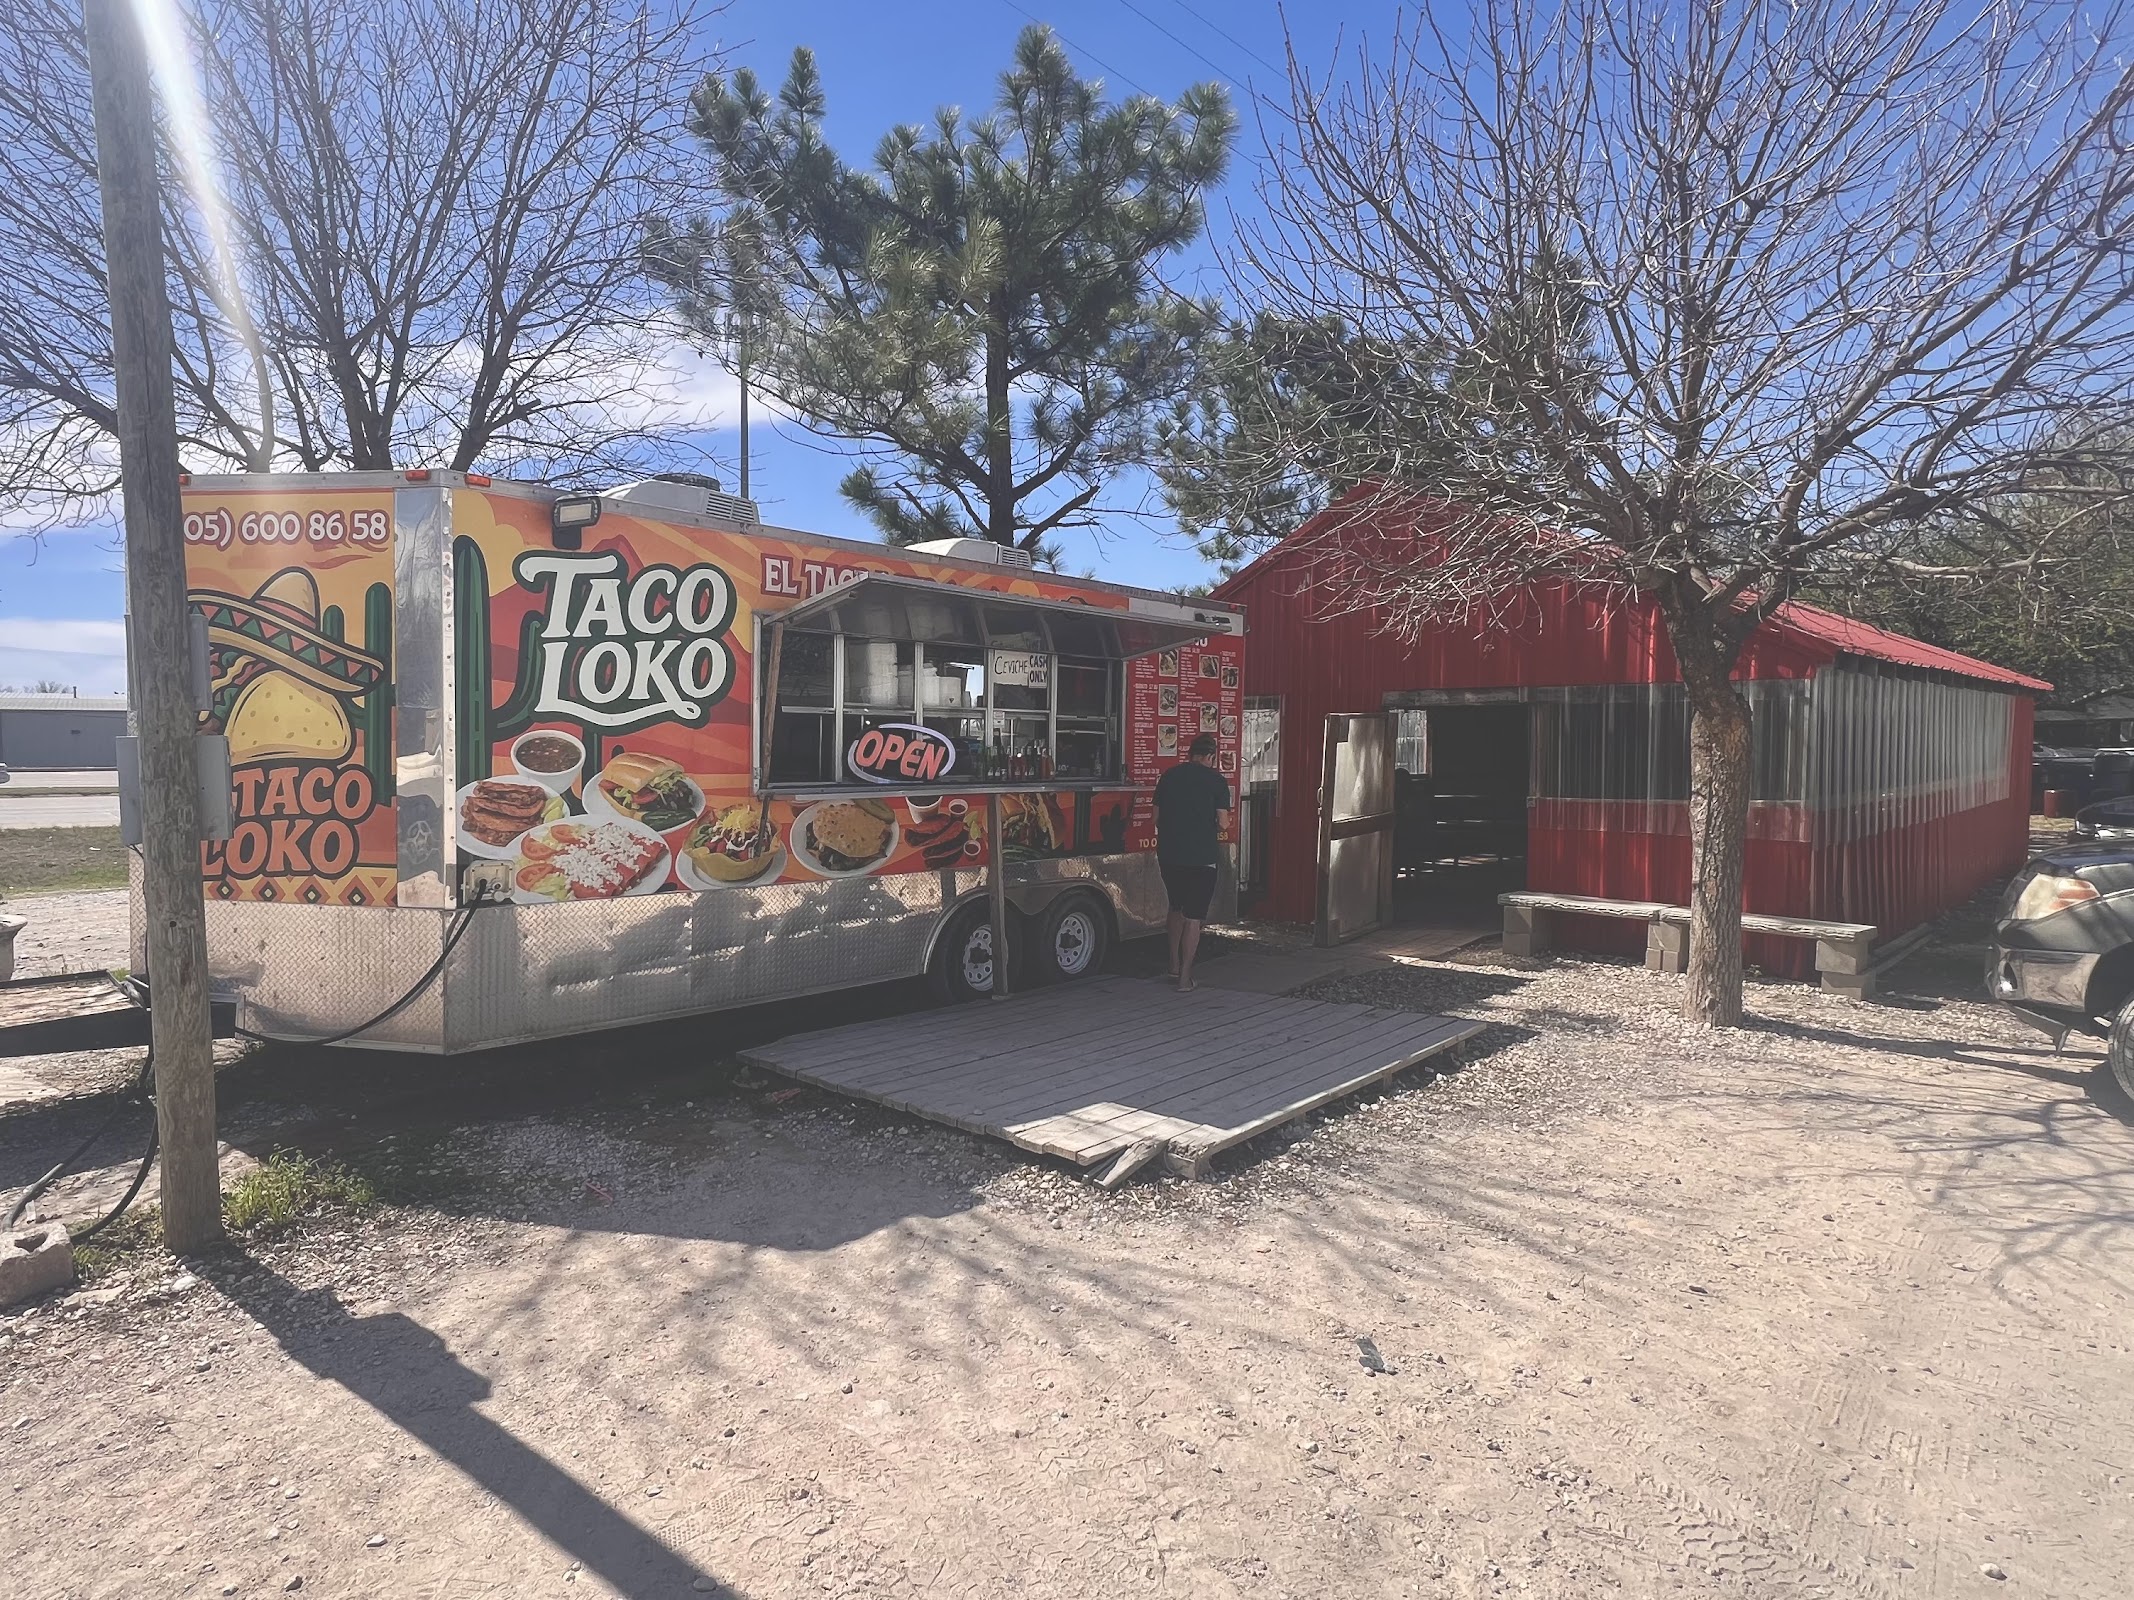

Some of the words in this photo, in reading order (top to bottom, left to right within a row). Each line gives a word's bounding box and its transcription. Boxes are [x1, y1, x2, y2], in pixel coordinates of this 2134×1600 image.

[183, 509, 232, 547] 05)
[241, 513, 300, 541] 600
[308, 512, 343, 541] 86
[352, 512, 387, 540] 58
[519, 554, 728, 638] TACO
[764, 557, 798, 594] EL
[804, 563, 863, 597] TAC
[534, 637, 728, 726] LOKO
[1029, 654, 1048, 668] CASH
[1029, 670, 1047, 683] ONLY
[855, 730, 946, 780] OPEN
[233, 766, 372, 819] TACO
